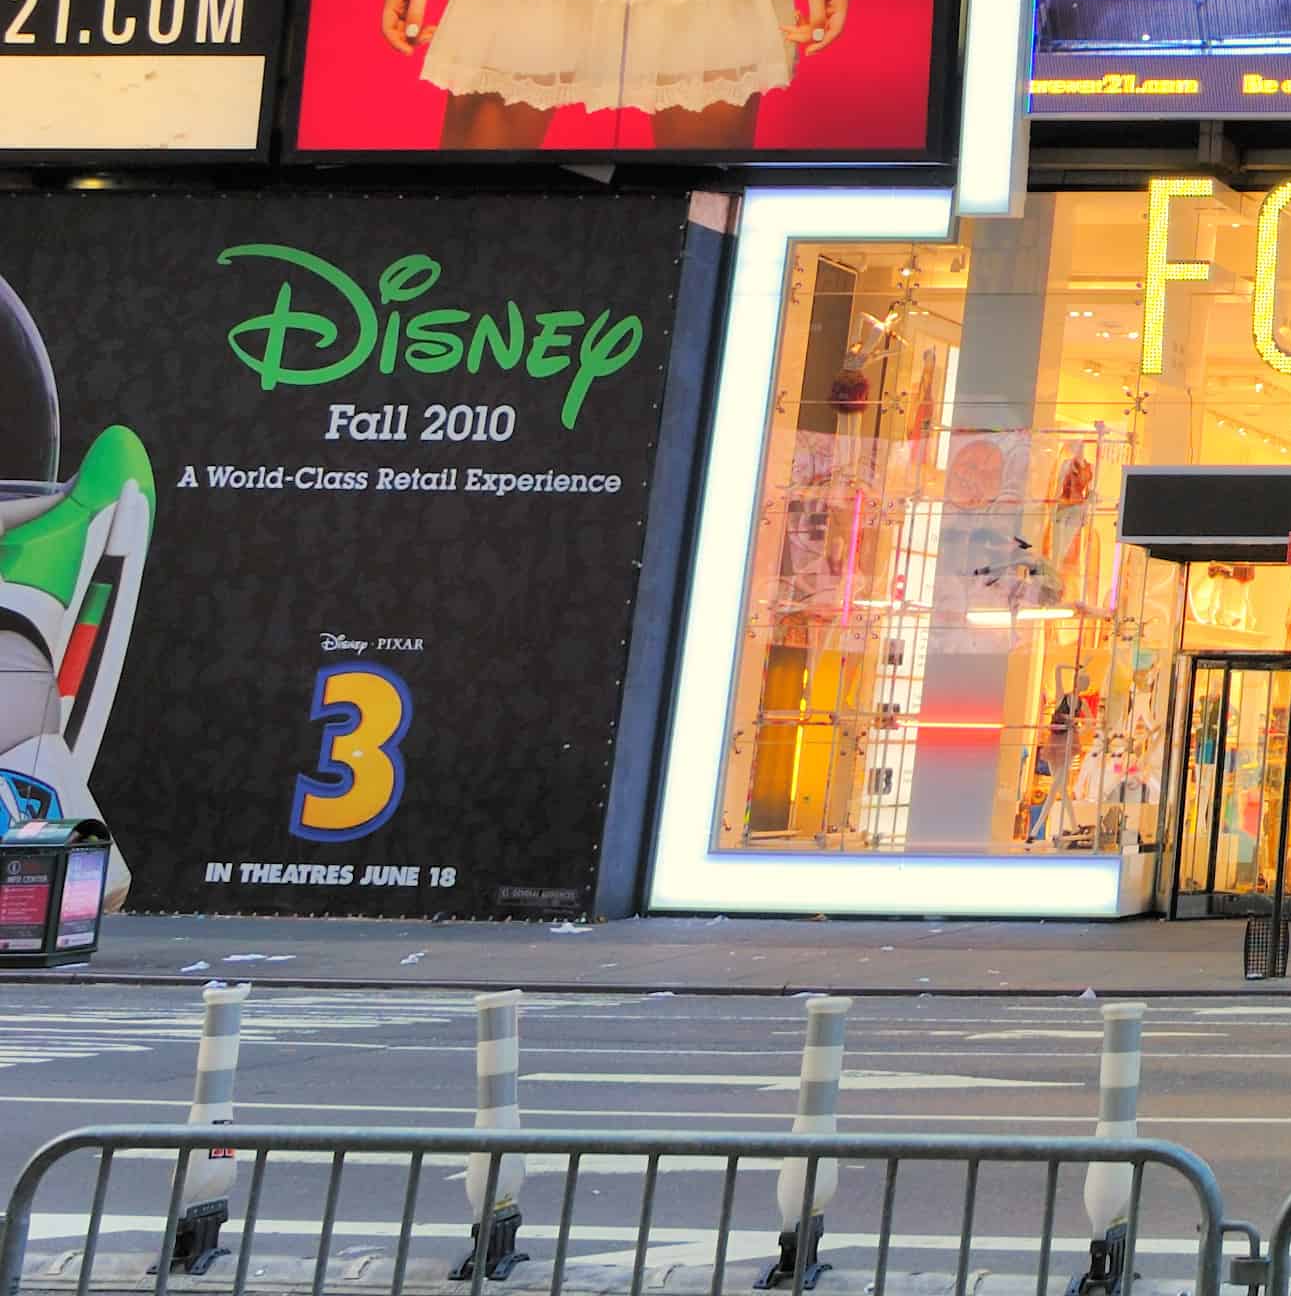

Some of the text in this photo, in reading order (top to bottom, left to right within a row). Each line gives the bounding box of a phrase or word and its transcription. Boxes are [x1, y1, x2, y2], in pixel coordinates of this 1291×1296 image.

[325, 404, 516, 442] Fall 2010
[177, 466, 622, 496] A World-Class Retail Experience
[376, 638, 424, 651] PIXAR
[289, 660, 413, 841] 3
[205, 862, 456, 887] IN THEATRES JUNE 18
